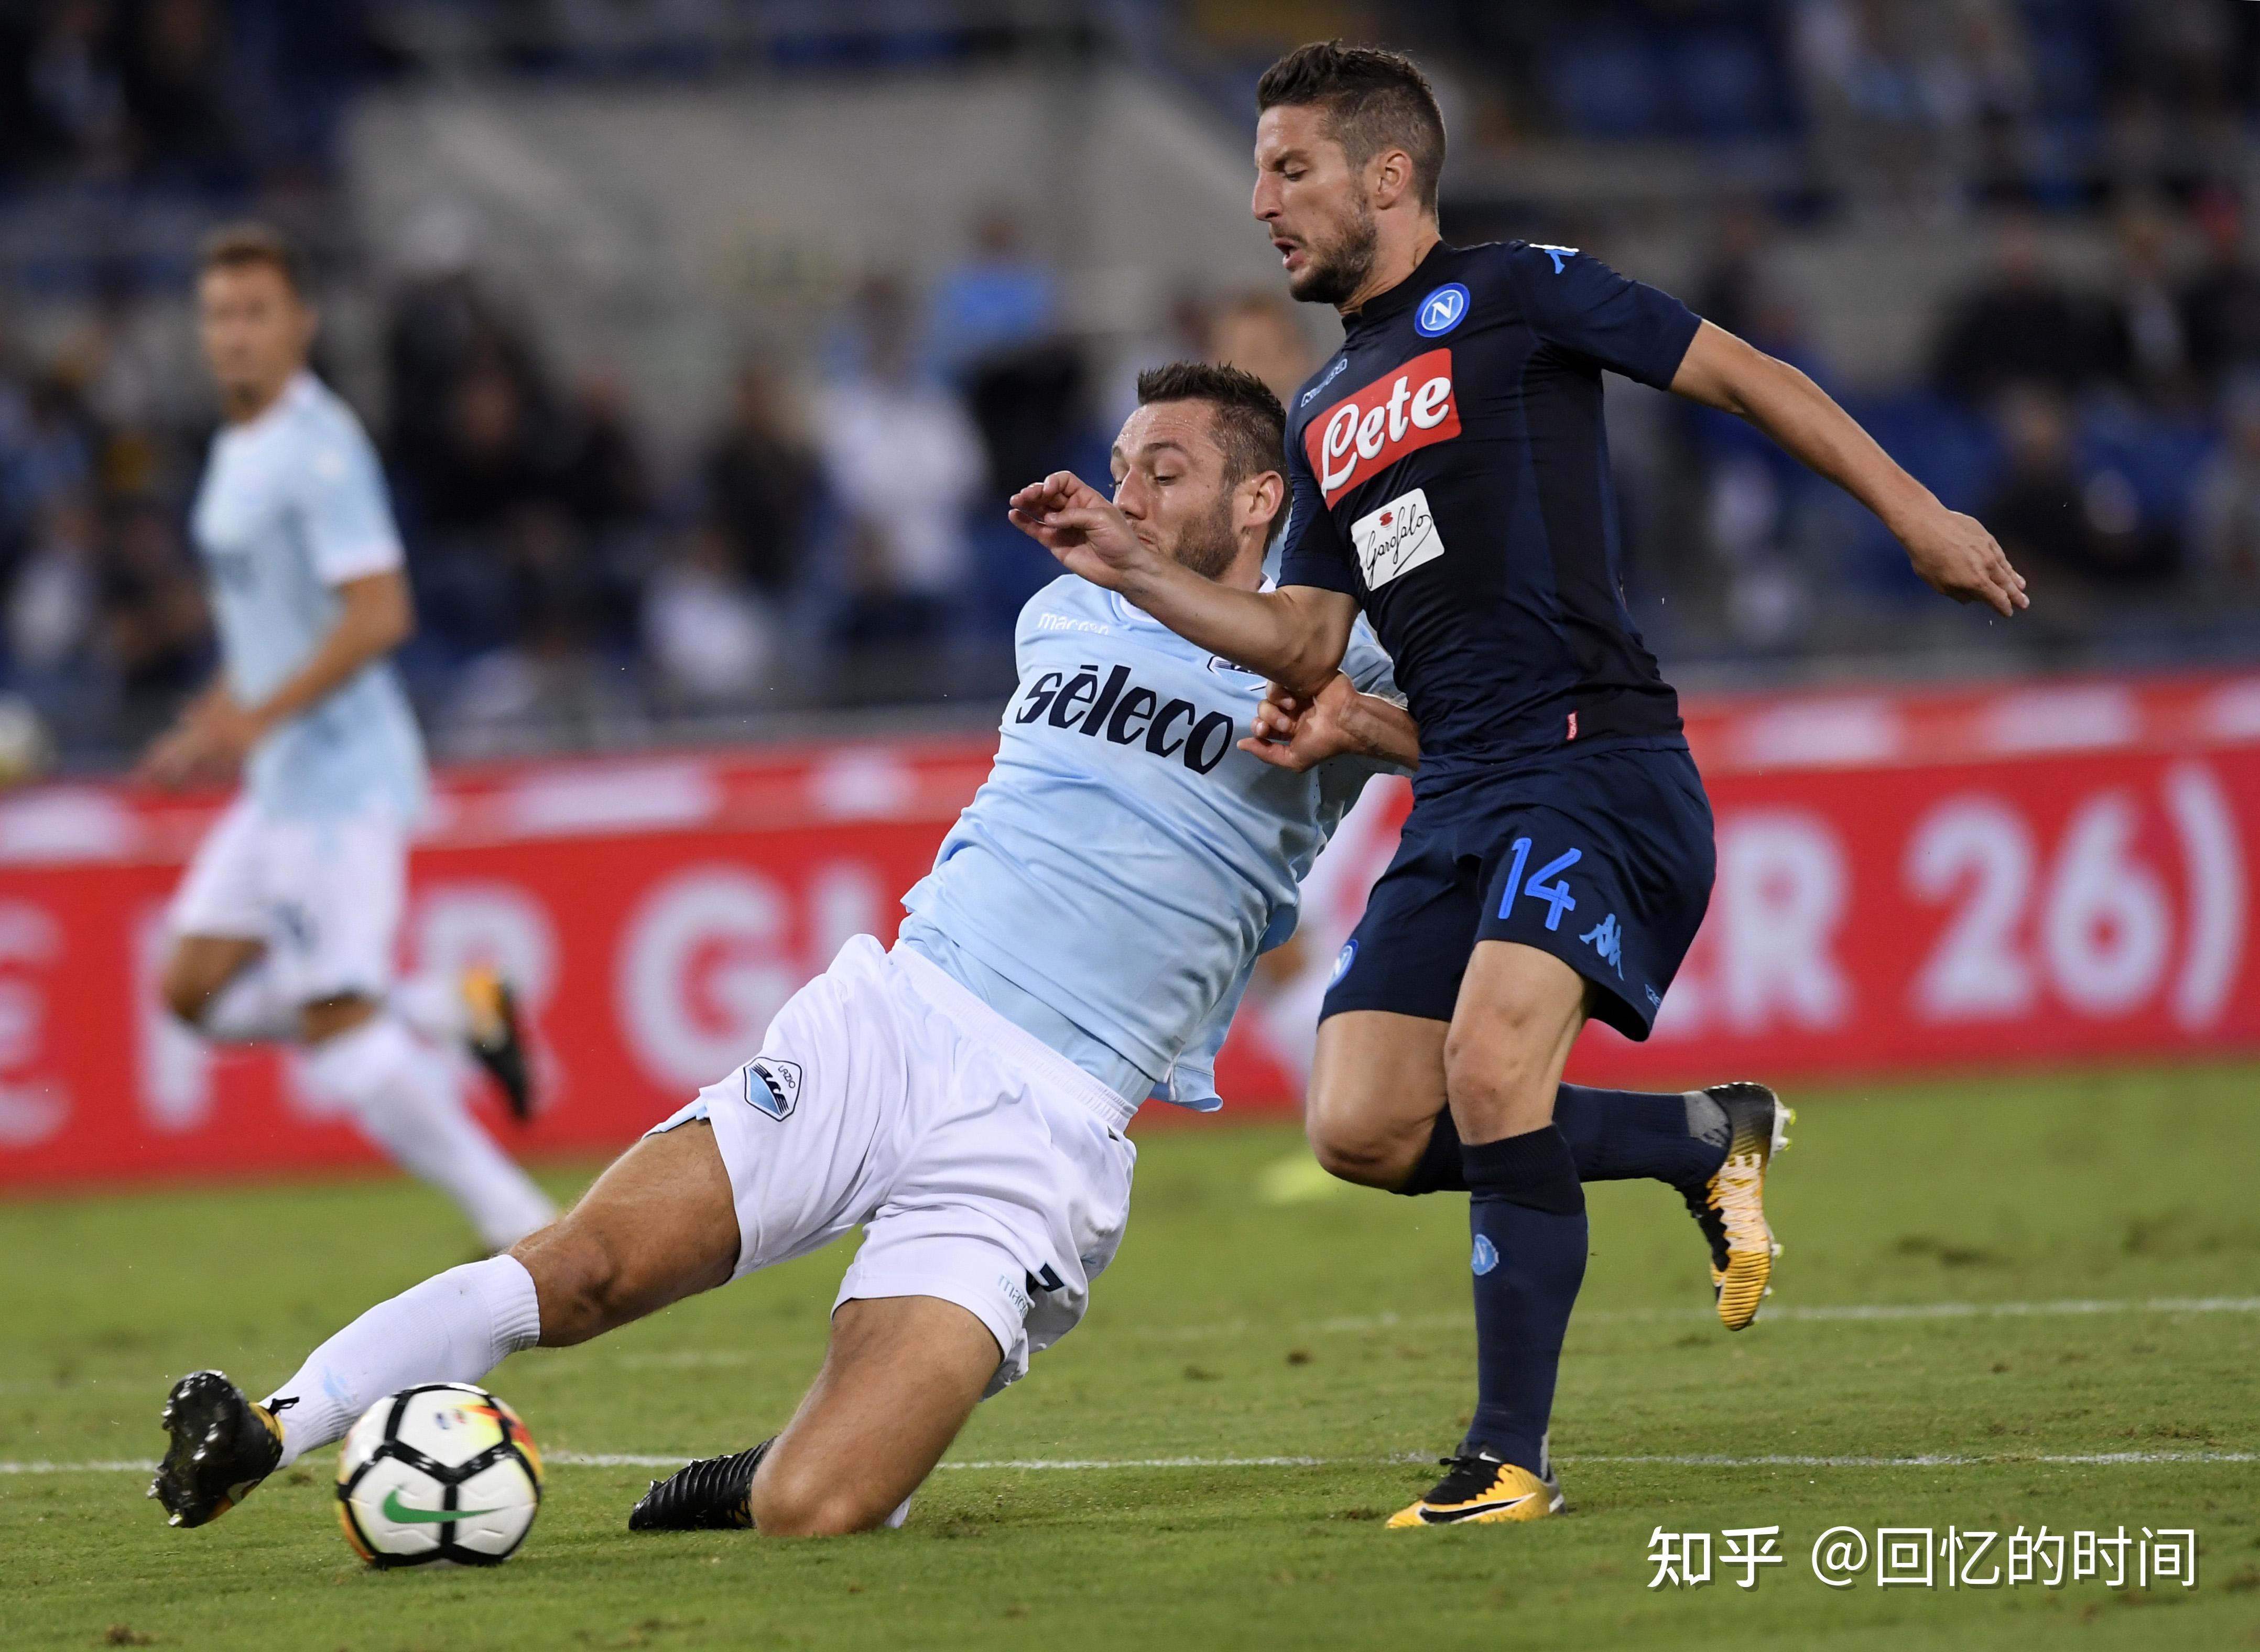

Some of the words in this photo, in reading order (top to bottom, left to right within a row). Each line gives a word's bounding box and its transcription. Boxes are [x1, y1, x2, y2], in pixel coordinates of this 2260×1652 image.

[1321, 375, 1451, 501] Lete
[1366, 503, 1432, 590] Garofalo
[1497, 838, 1582, 931] 14
[1903, 758, 2245, 1034] 26)
[777, 1064, 796, 1089] LAZIO
